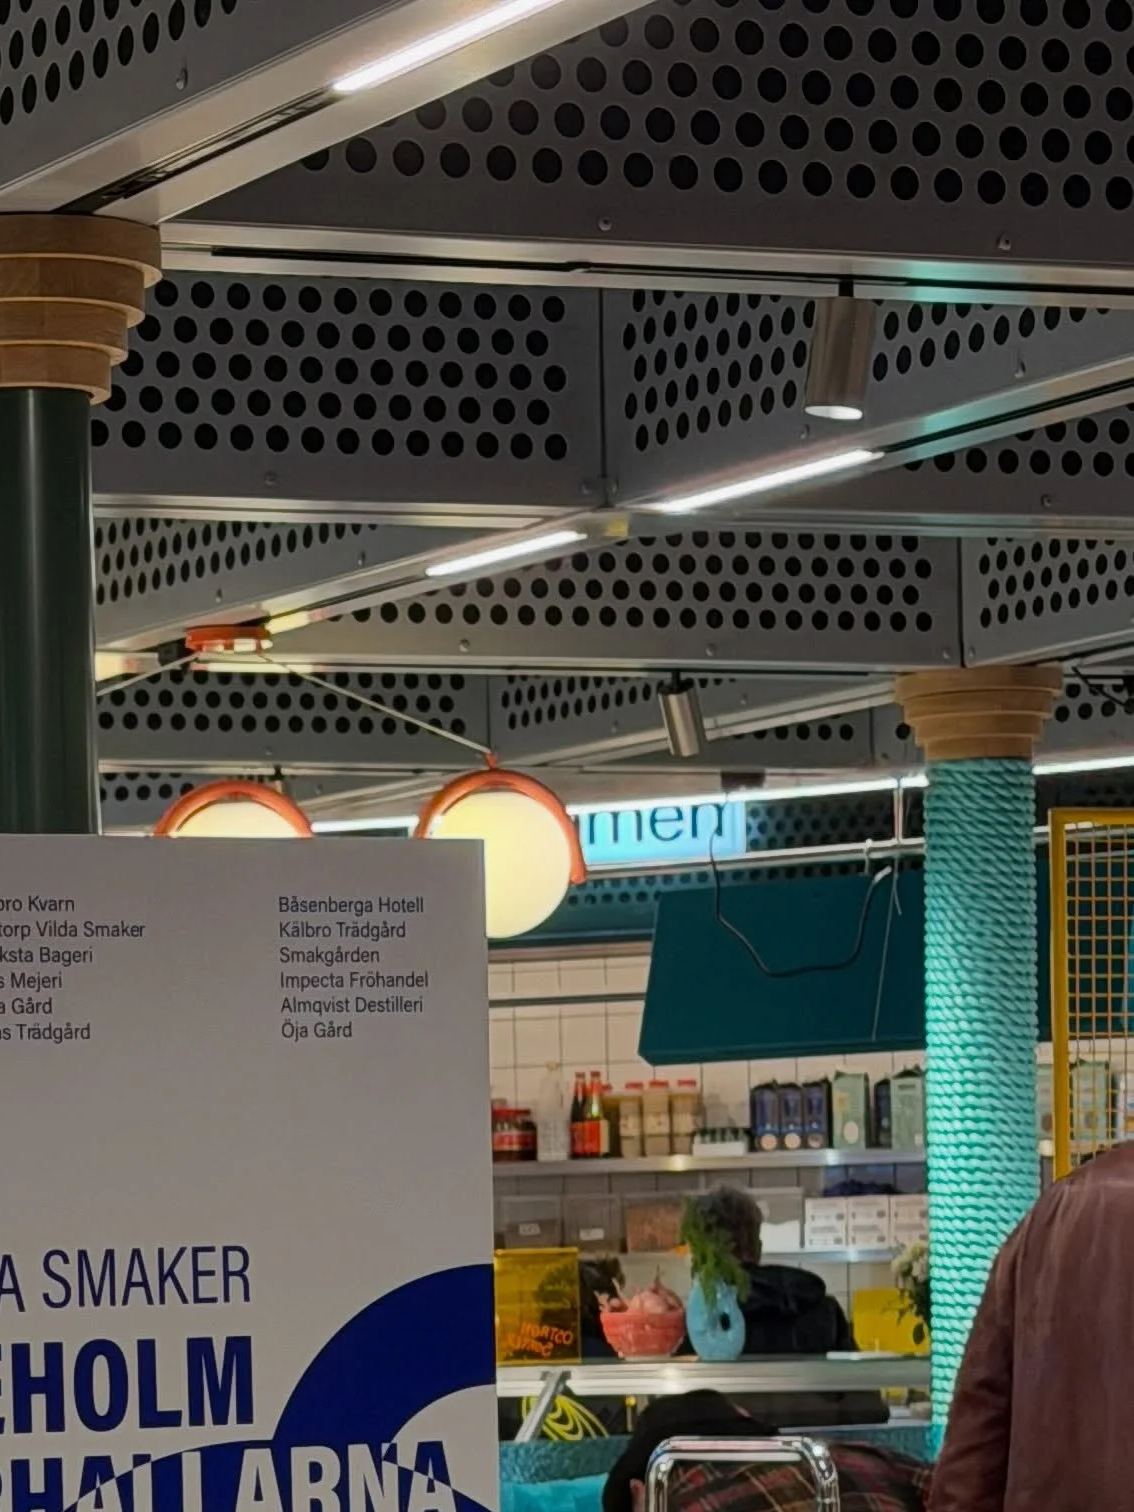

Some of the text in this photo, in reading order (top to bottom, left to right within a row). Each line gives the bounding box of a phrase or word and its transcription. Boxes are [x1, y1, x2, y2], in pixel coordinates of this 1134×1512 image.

[29, 896, 75, 912] Kvarn
[279, 896, 424, 917] Båsenberga Hotell
[37, 920, 78, 937] Vilda
[84, 920, 146, 938] Smaker
[280, 920, 406, 942] Kälbro Trädgård
[40, 947, 94, 967] Bageri
[280, 945, 380, 967] Smakgården
[12, 972, 63, 993] Mejeri
[281, 971, 429, 992] Impecta Fröhandel
[13, 997, 53, 1015] Gård
[281, 996, 424, 1018] Almqvist Destilleri
[15, 1022, 91, 1044] Trädgård
[282, 1019, 353, 1042] Öja Gård
[41, 1245, 251, 1309] SMAKER
